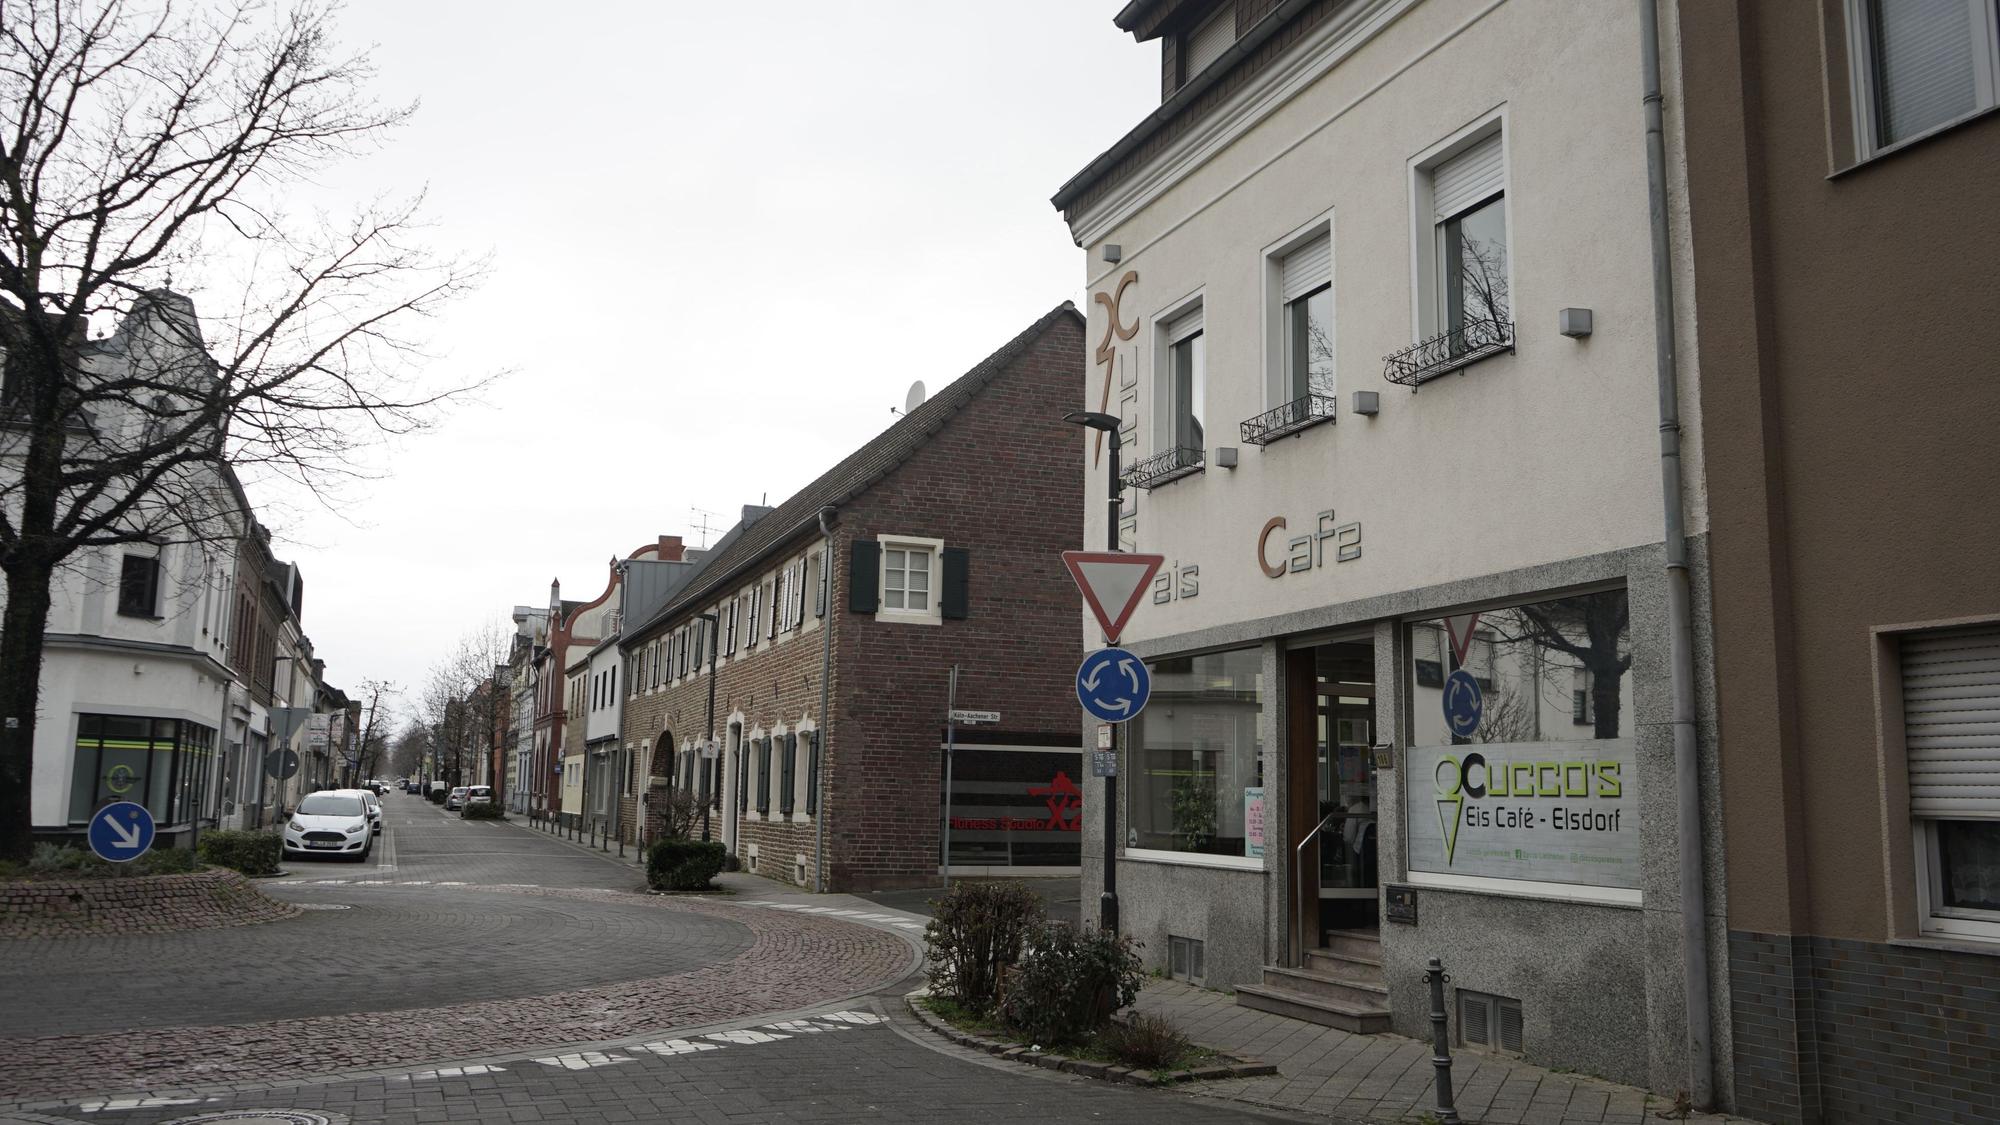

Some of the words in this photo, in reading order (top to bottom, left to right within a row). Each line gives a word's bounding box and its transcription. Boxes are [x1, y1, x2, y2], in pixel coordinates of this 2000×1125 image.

[1258, 508, 1361, 579] Cafe
[1466, 806, 1490, 827] Eis
[1495, 807, 1534, 829] Café
[1552, 807, 1621, 832] Elsdorf
